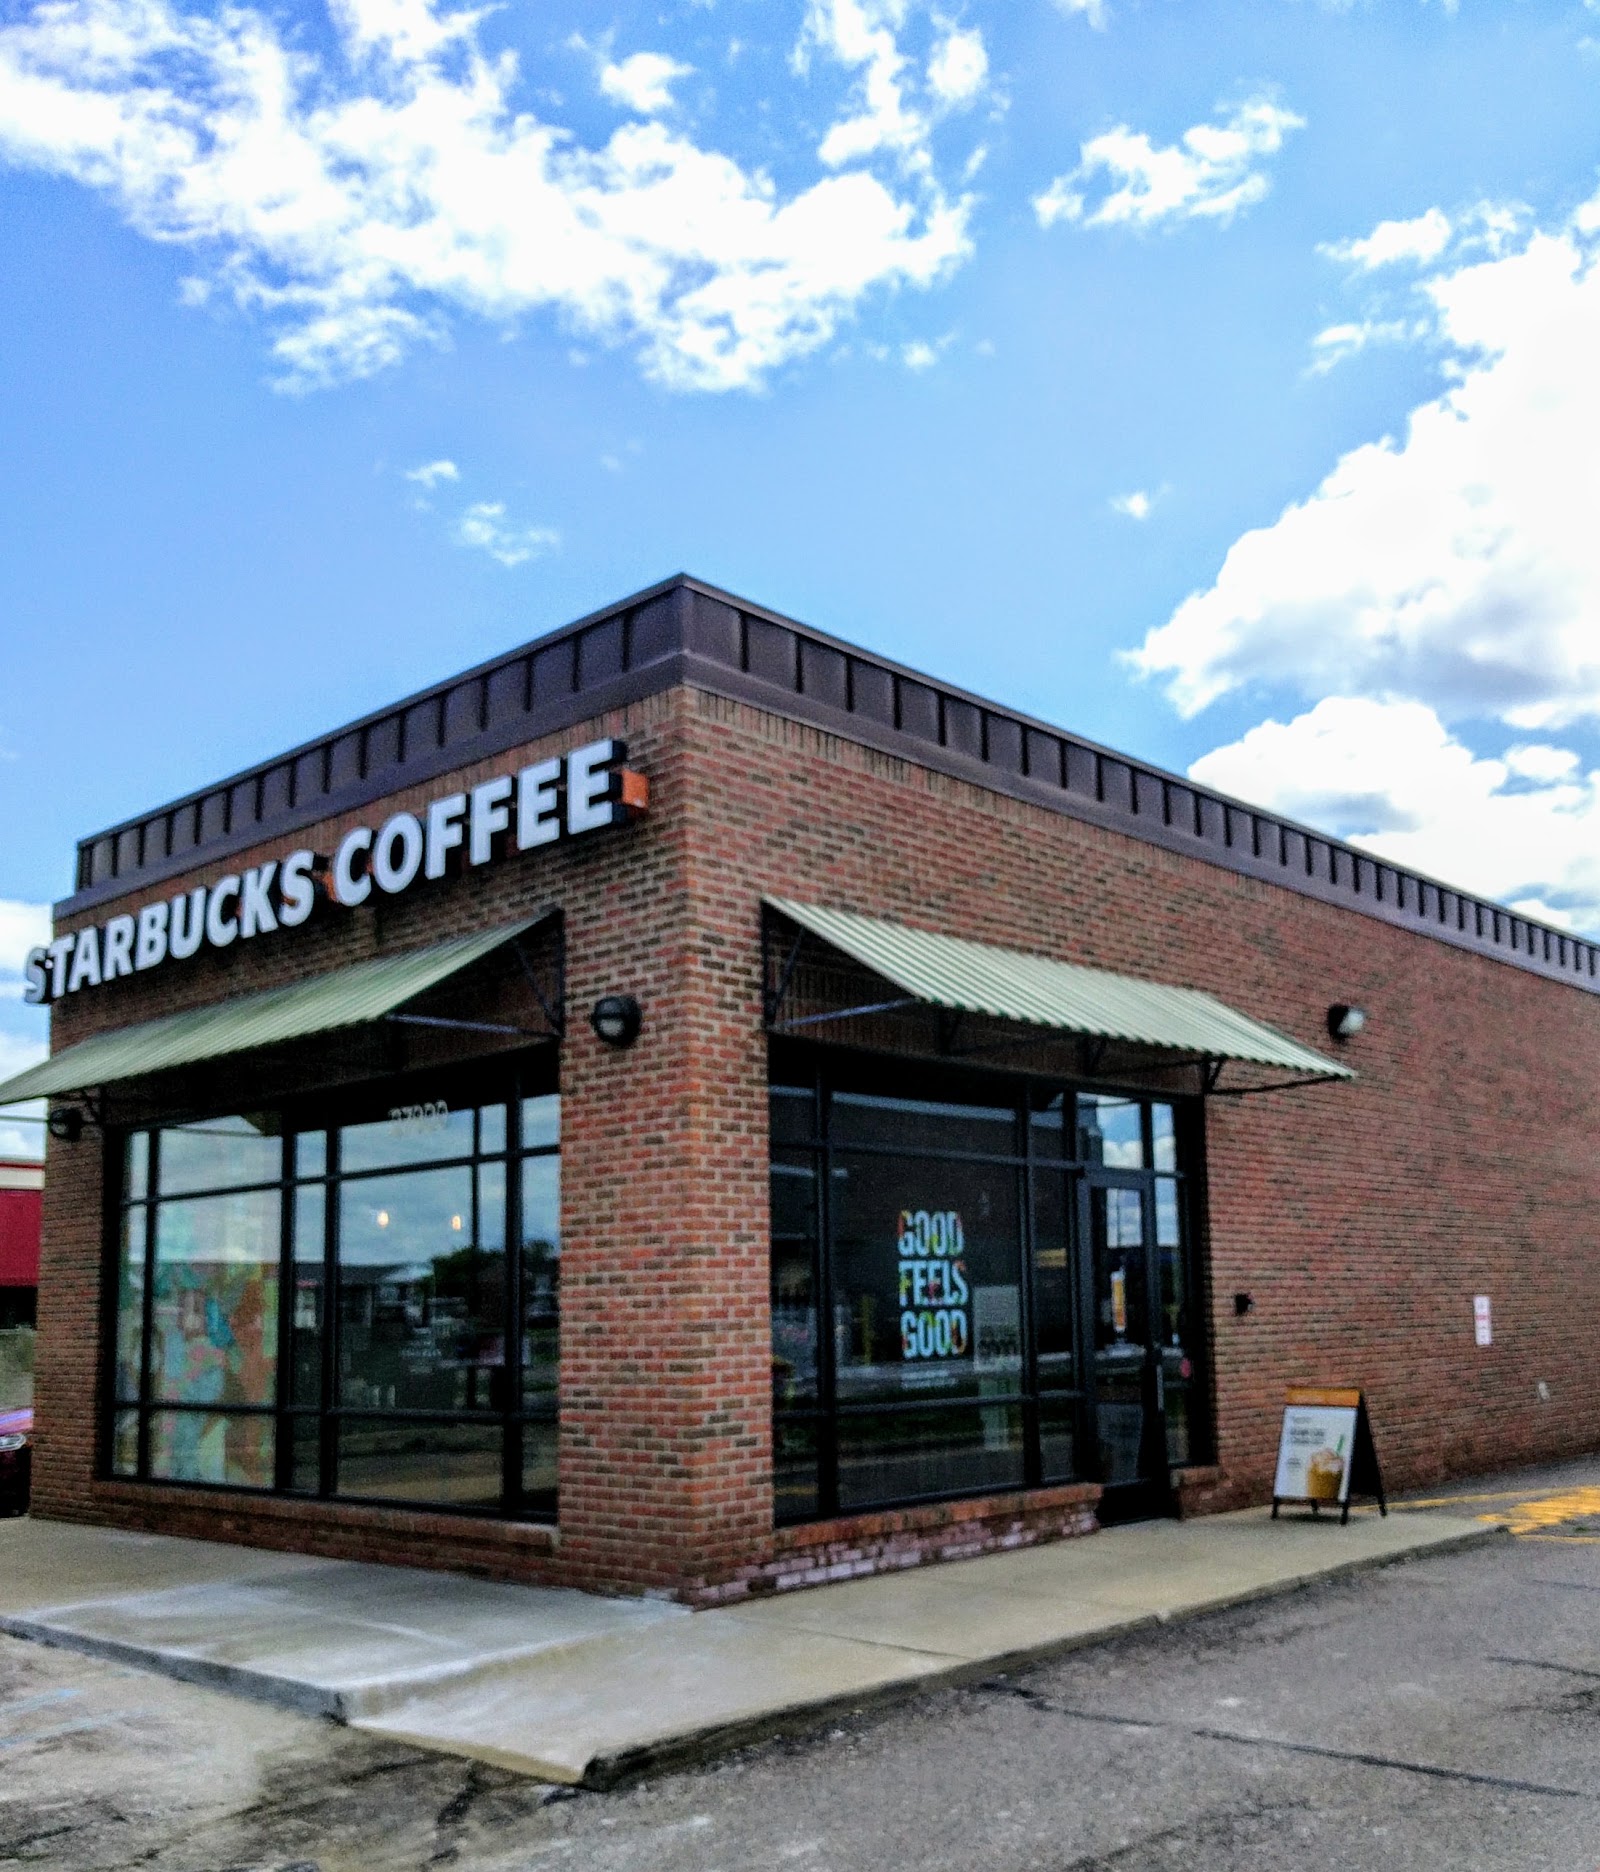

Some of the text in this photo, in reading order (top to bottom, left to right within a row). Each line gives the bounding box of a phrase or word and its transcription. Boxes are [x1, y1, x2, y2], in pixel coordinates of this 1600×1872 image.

[24, 738, 613, 1004] STARBUCKS COFFEE
[898, 1210, 964, 1256] GOOD
[898, 1260, 969, 1306] FEELS
[902, 1309, 967, 1358] GOOD
